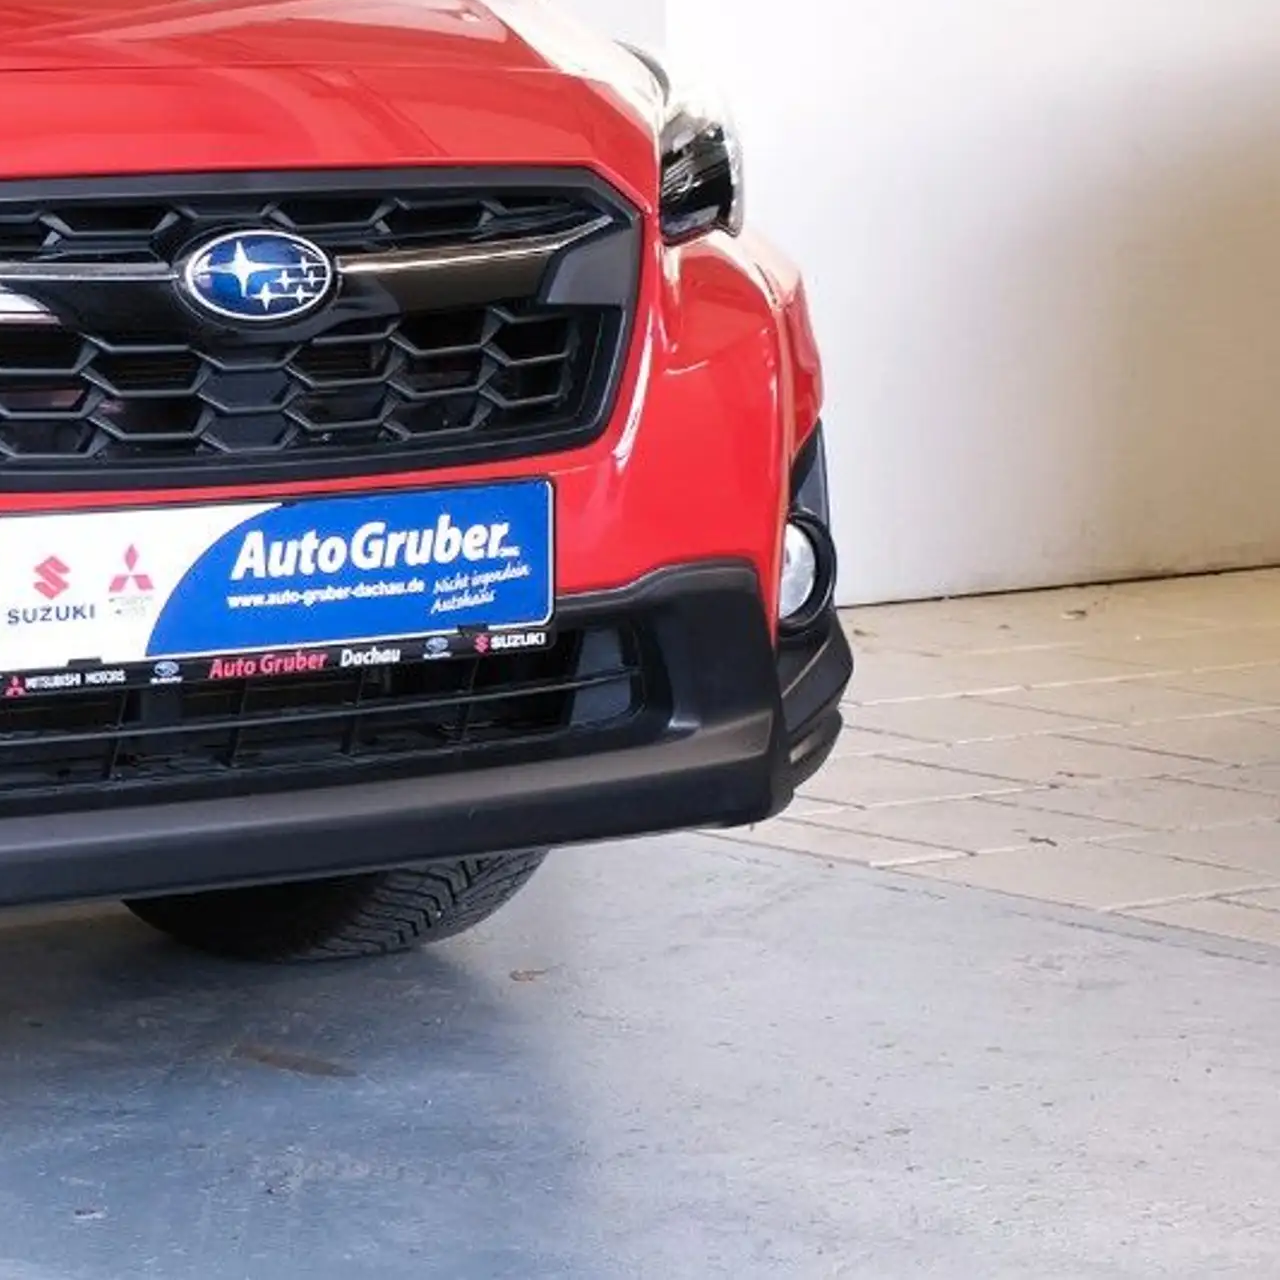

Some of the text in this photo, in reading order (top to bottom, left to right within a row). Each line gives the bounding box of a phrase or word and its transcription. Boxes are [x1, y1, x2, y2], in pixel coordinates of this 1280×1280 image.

[231, 514, 509, 580] Auto Gruber
[227, 577, 425, 608] www.auto-gruber-dachau.de
[7, 605, 96, 625] SUZUKI
[490, 632, 546, 650] SUZUKI
[209, 645, 401, 679] Auto Gruber Dachau
